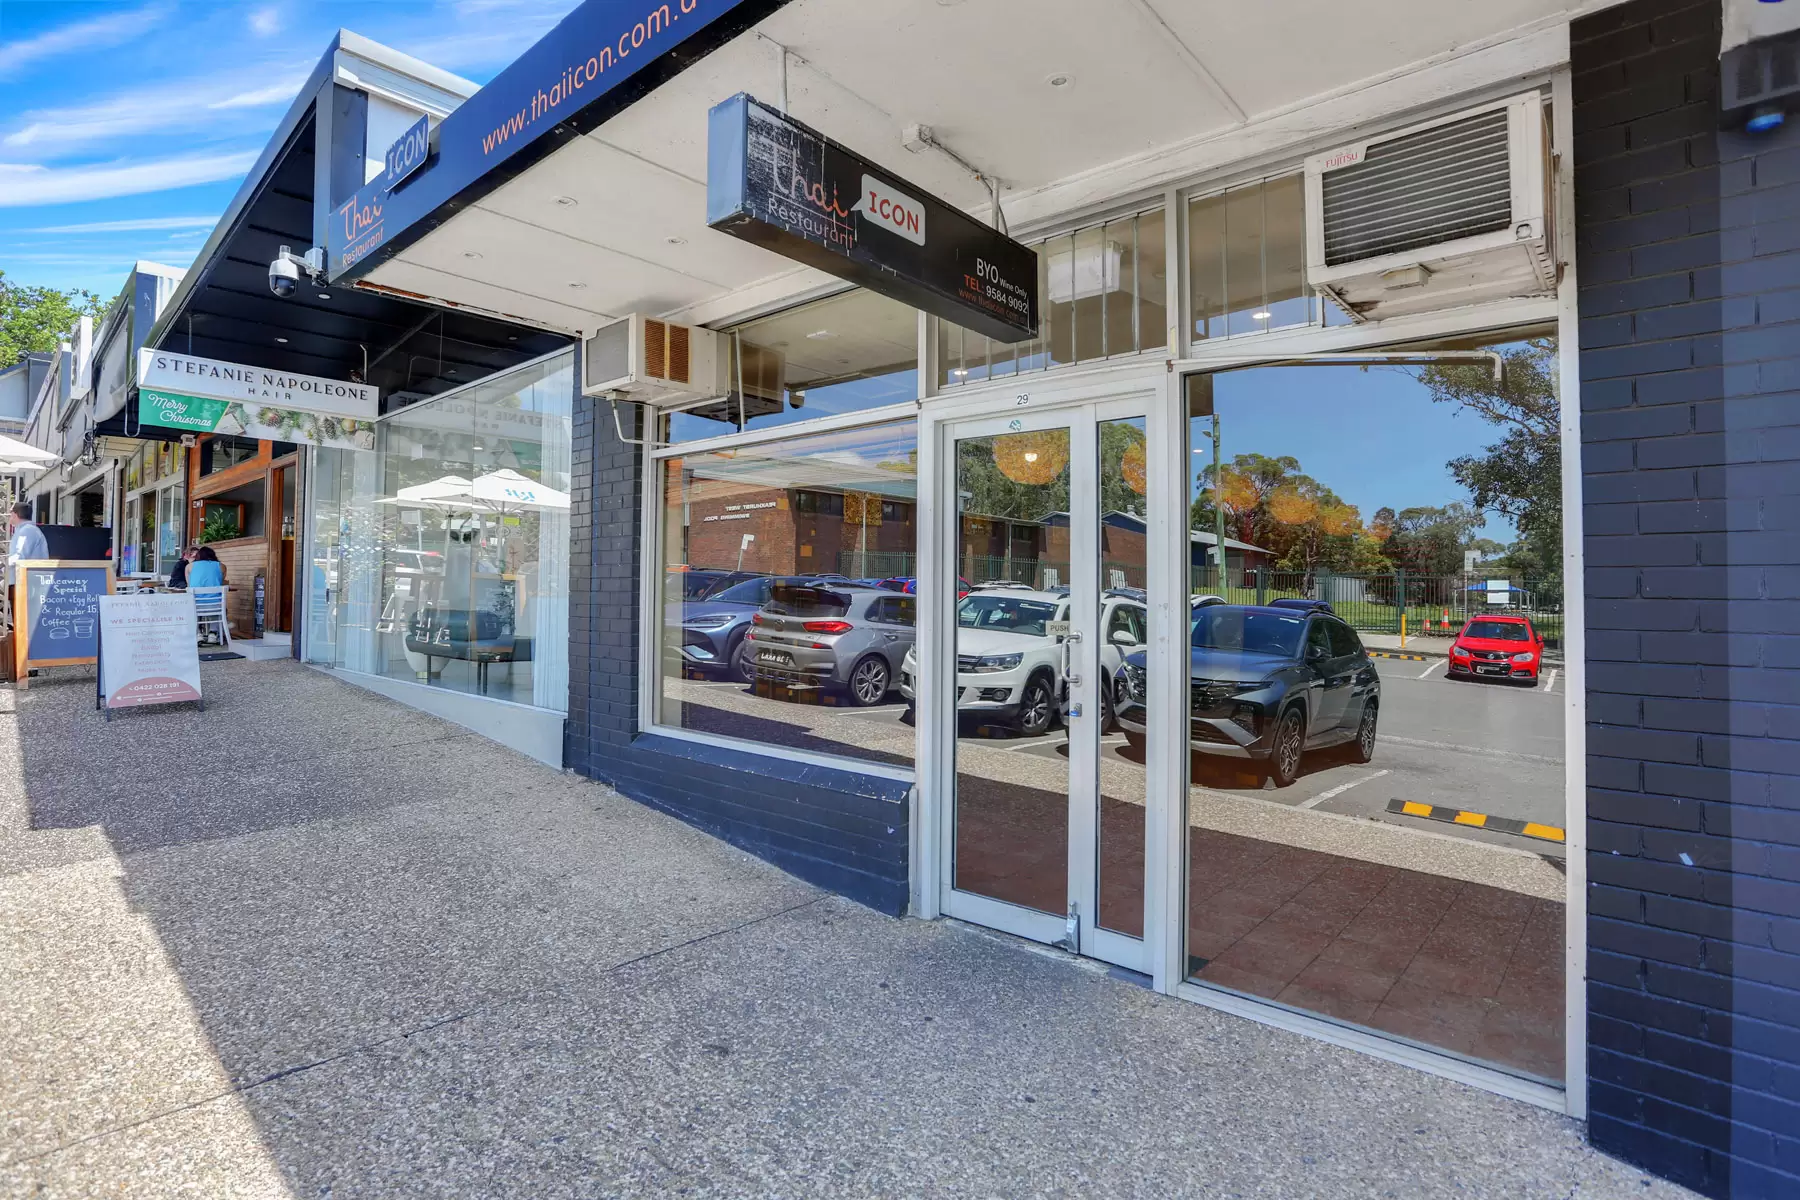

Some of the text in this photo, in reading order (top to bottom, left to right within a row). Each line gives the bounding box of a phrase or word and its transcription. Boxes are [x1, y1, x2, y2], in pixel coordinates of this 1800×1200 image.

[387, 123, 426, 180] ICON
[1325, 152, 1359, 168] FUJITSU
[757, 134, 849, 218] Thai
[339, 195, 383, 241] Thai
[868, 190, 920, 235] ICON
[768, 197, 854, 249] Restaurant
[342, 226, 385, 268] Restaurant
[976, 257, 1028, 300] BYO Wine Only
[986, 285, 1007, 304] 9584
[1008, 295, 1029, 314] 9092
[156, 356, 369, 401] STEFANIE NAPOLEONE
[247, 387, 292, 400] HAIR
[1016, 394, 1029, 405] 29
[148, 393, 188, 414] Merry
[159, 410, 212, 427] Christmas
[34, 574, 88, 587] Takeaway
[53, 584, 87, 595] Special
[40, 594, 66, 604] Bacon
[42, 605, 51, 614] &
[55, 607, 86, 619] Regular
[42, 617, 71, 627] Coffee
[1050, 624, 1069, 632] PUSH
